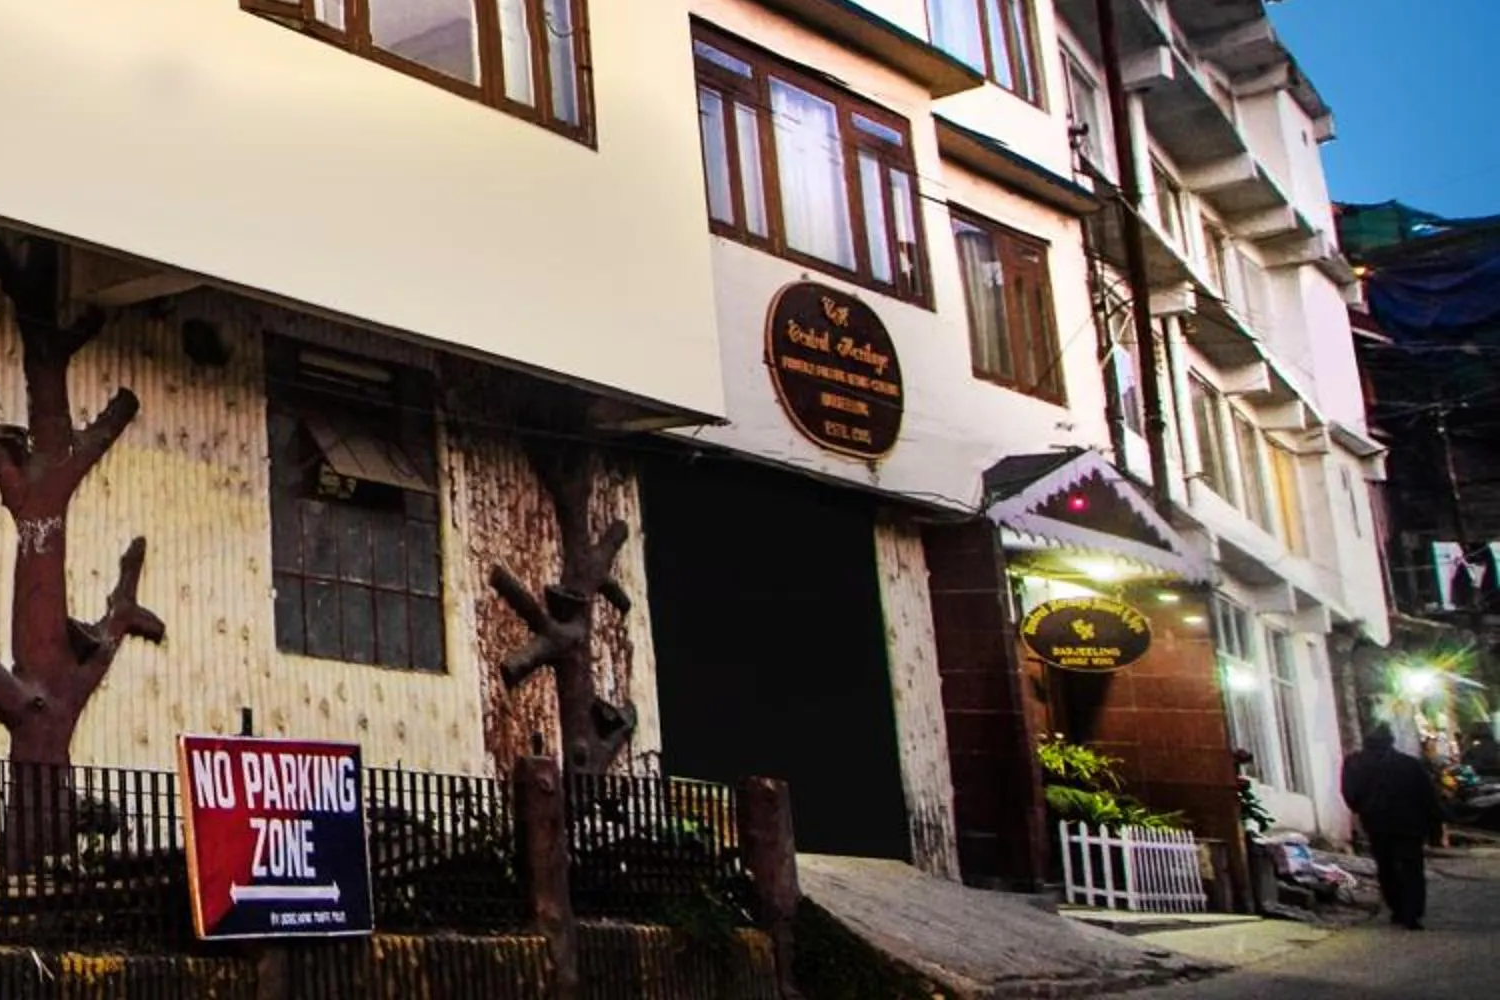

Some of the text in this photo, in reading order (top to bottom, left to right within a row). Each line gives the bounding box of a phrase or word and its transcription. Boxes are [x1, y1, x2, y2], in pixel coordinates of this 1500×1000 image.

[192, 750, 357, 813] NO PARKING
[250, 817, 317, 878] ZONE
